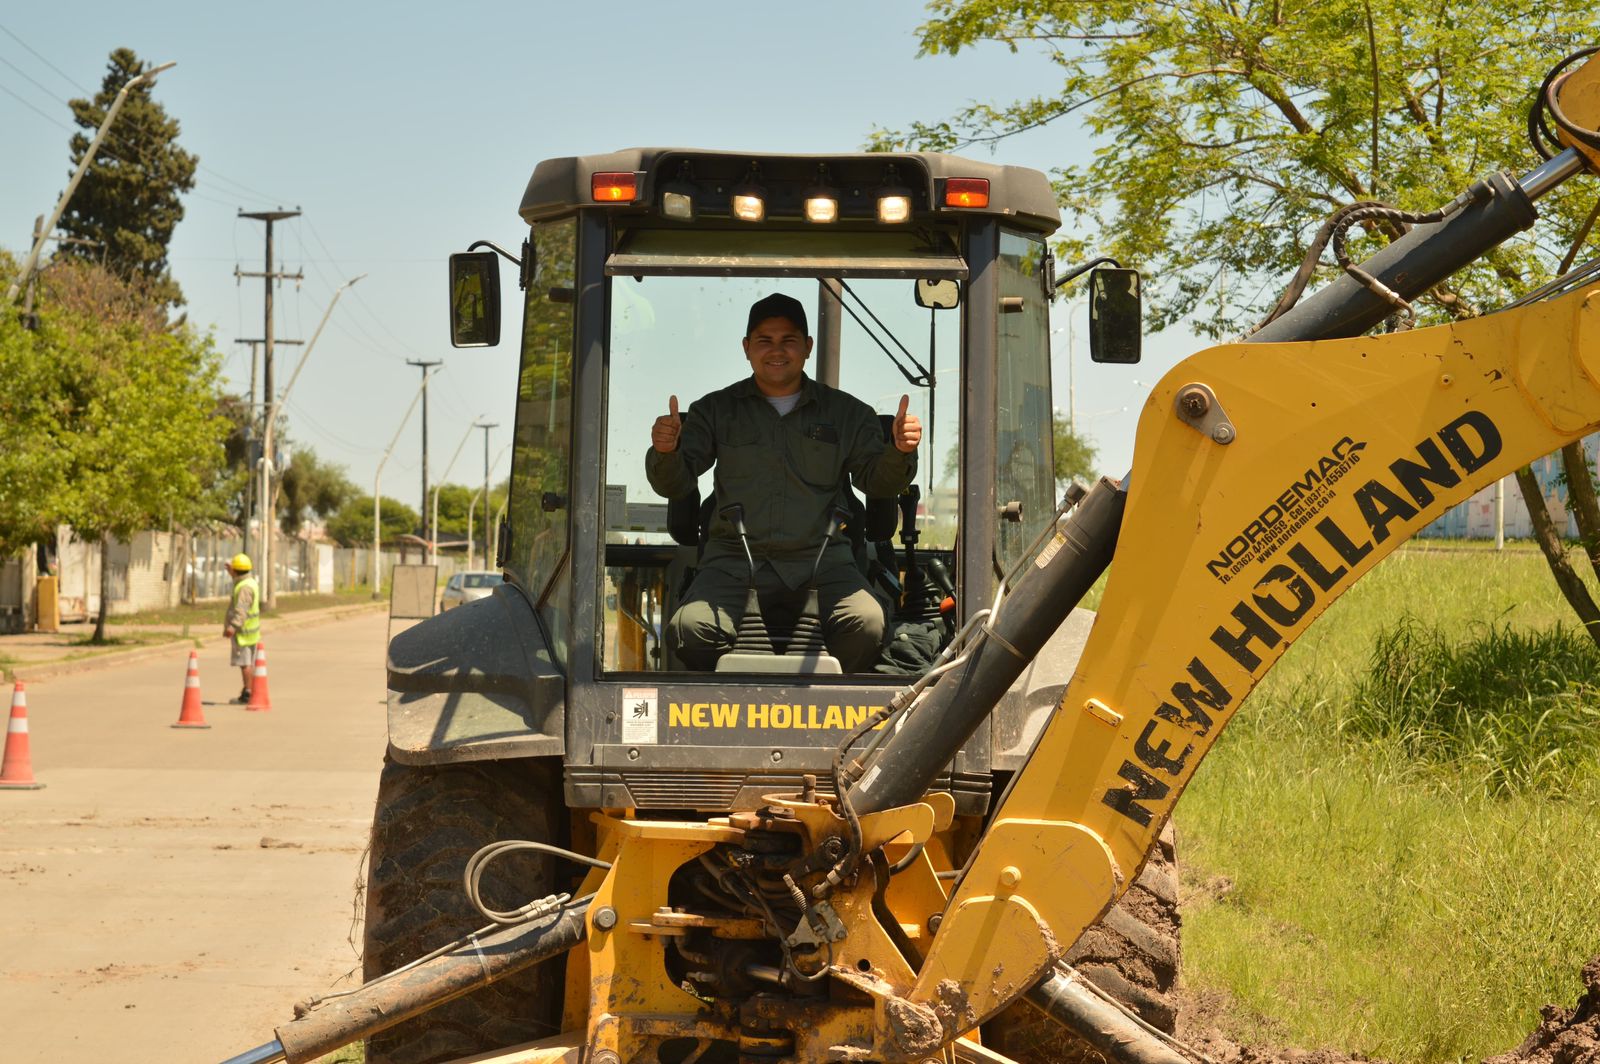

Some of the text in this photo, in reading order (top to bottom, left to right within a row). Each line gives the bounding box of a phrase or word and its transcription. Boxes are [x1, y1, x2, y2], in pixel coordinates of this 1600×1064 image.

[1206, 436, 1367, 578] NORDEMAQ
[1326, 452, 1360, 486] 4556716
[1101, 411, 1502, 827] NEW HOLLAND
[669, 703, 740, 727] NEW
